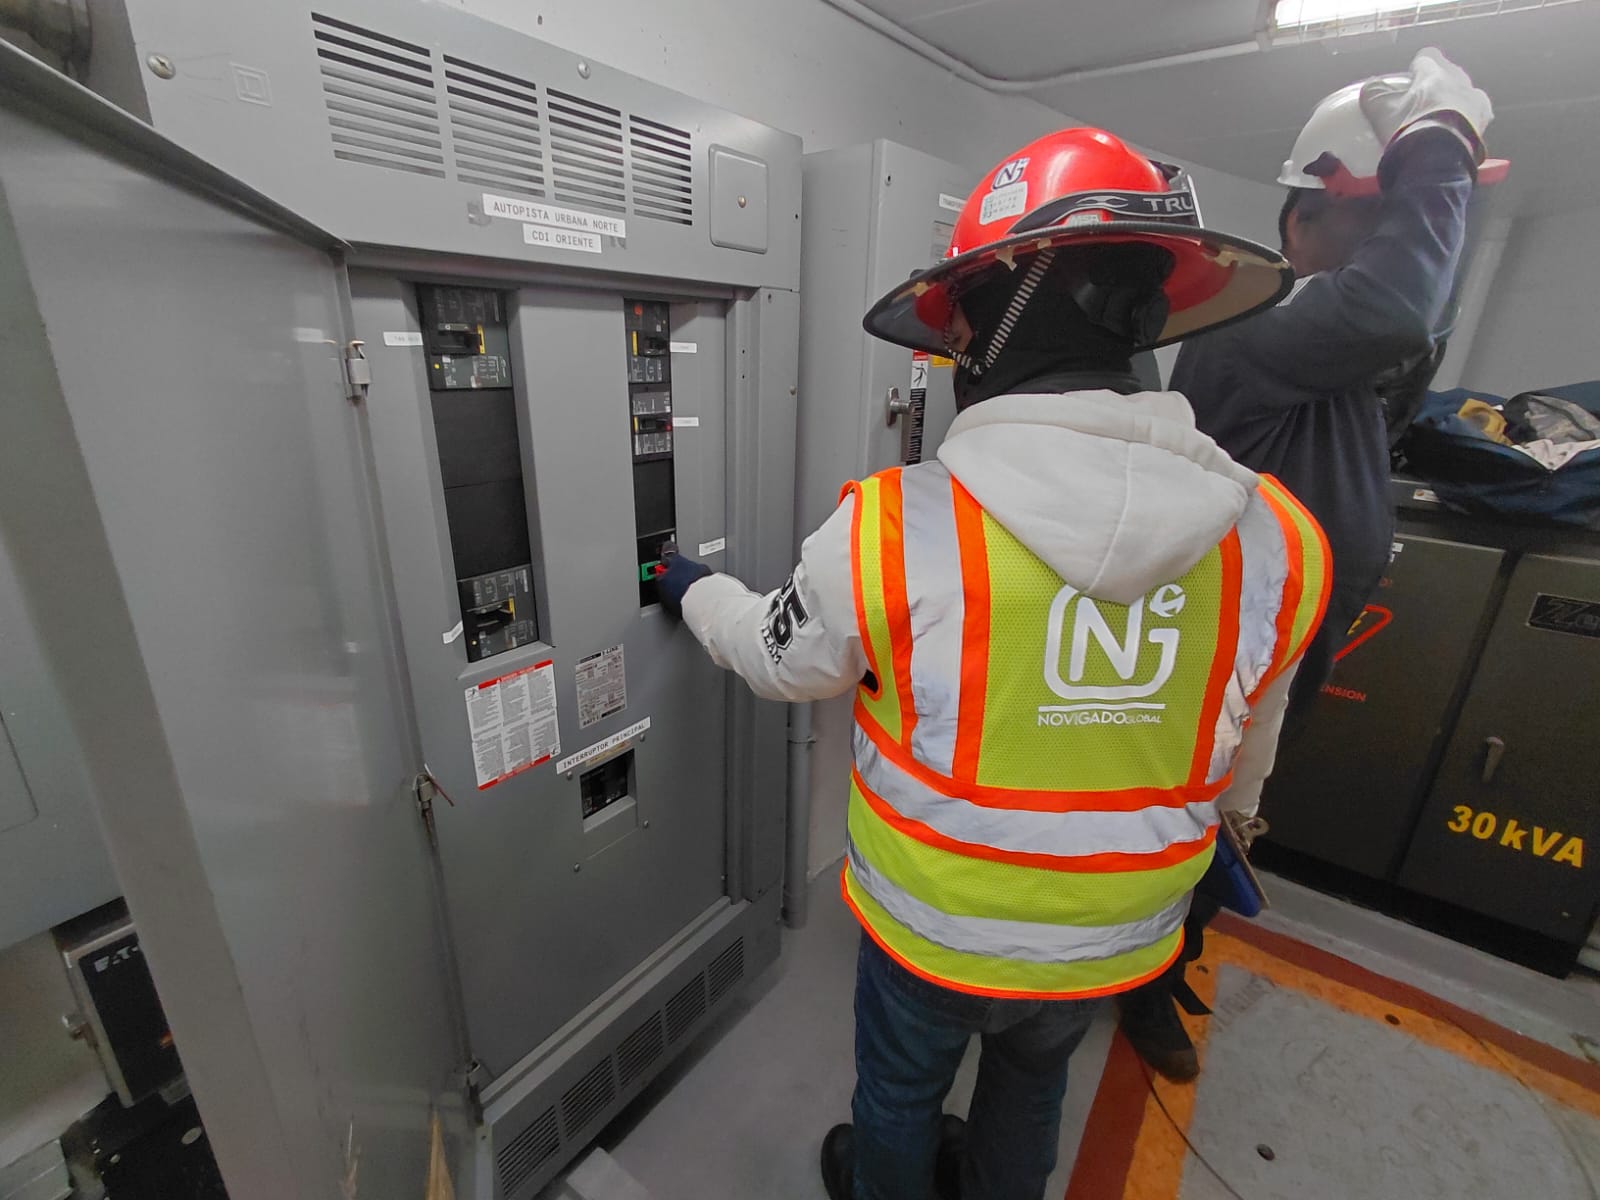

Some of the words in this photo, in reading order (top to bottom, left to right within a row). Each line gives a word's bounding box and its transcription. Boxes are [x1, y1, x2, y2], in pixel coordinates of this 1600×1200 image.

[493, 201, 550, 220] AUTOPISTA
[555, 212, 588, 227] URBANA
[592, 219, 618, 233] NORTE
[555, 233, 593, 248] ORIENTE
[563, 741, 609, 769] INTERRUPTOR
[612, 723, 646, 744] PRINCIPAL
[1447, 804, 1497, 840] 30
[1499, 819, 1584, 869] kVA
[94, 945, 139, 973] EAT
